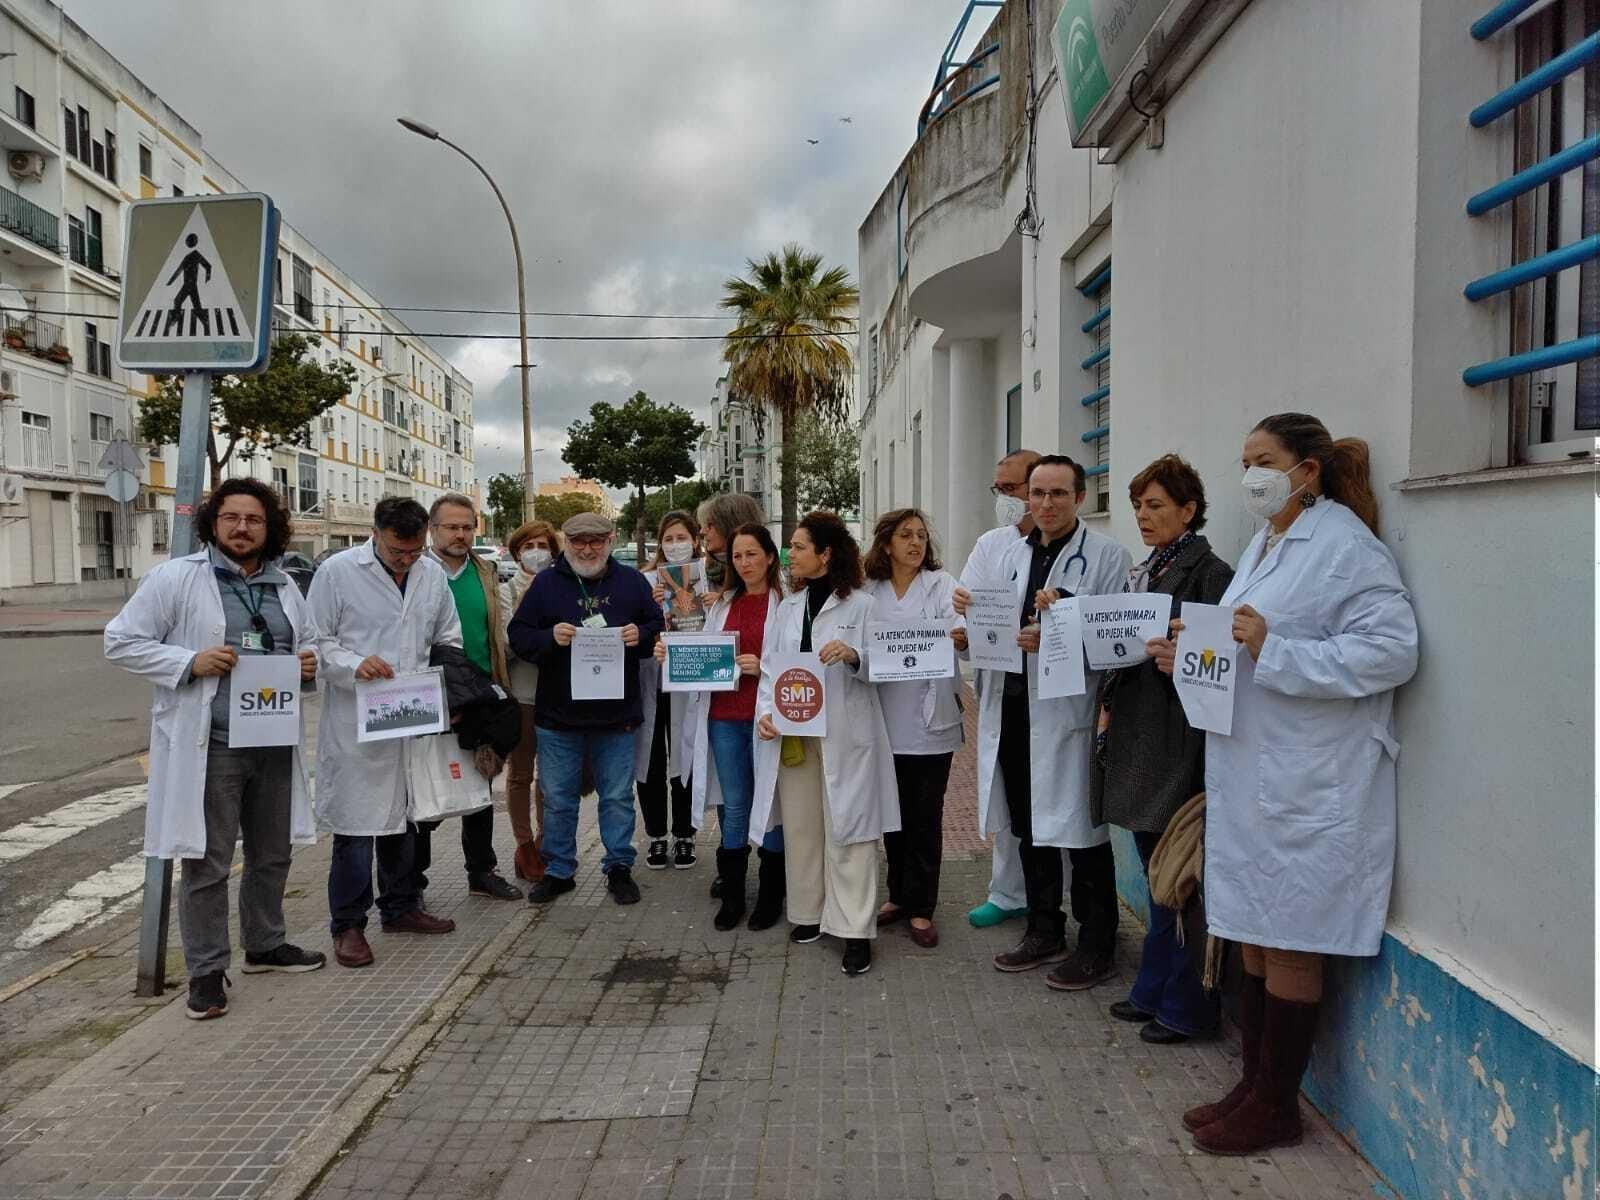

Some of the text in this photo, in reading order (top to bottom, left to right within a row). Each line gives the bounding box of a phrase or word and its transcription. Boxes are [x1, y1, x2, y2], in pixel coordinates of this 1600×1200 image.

[1084, 609, 1156, 623] "LA ATENCIÓN PRIMARIA
[874, 629, 946, 641] "LA ATENCIÓN PRIMARIA
[1096, 625, 1140, 639] NO PUEDE MÁS"
[887, 642, 935, 653] NO PUEDE MÁS"
[1182, 652, 1231, 682] SMP
[240, 690, 294, 710] SMP
[781, 686, 815, 702] SMP
[787, 709, 810, 719] 20 E
